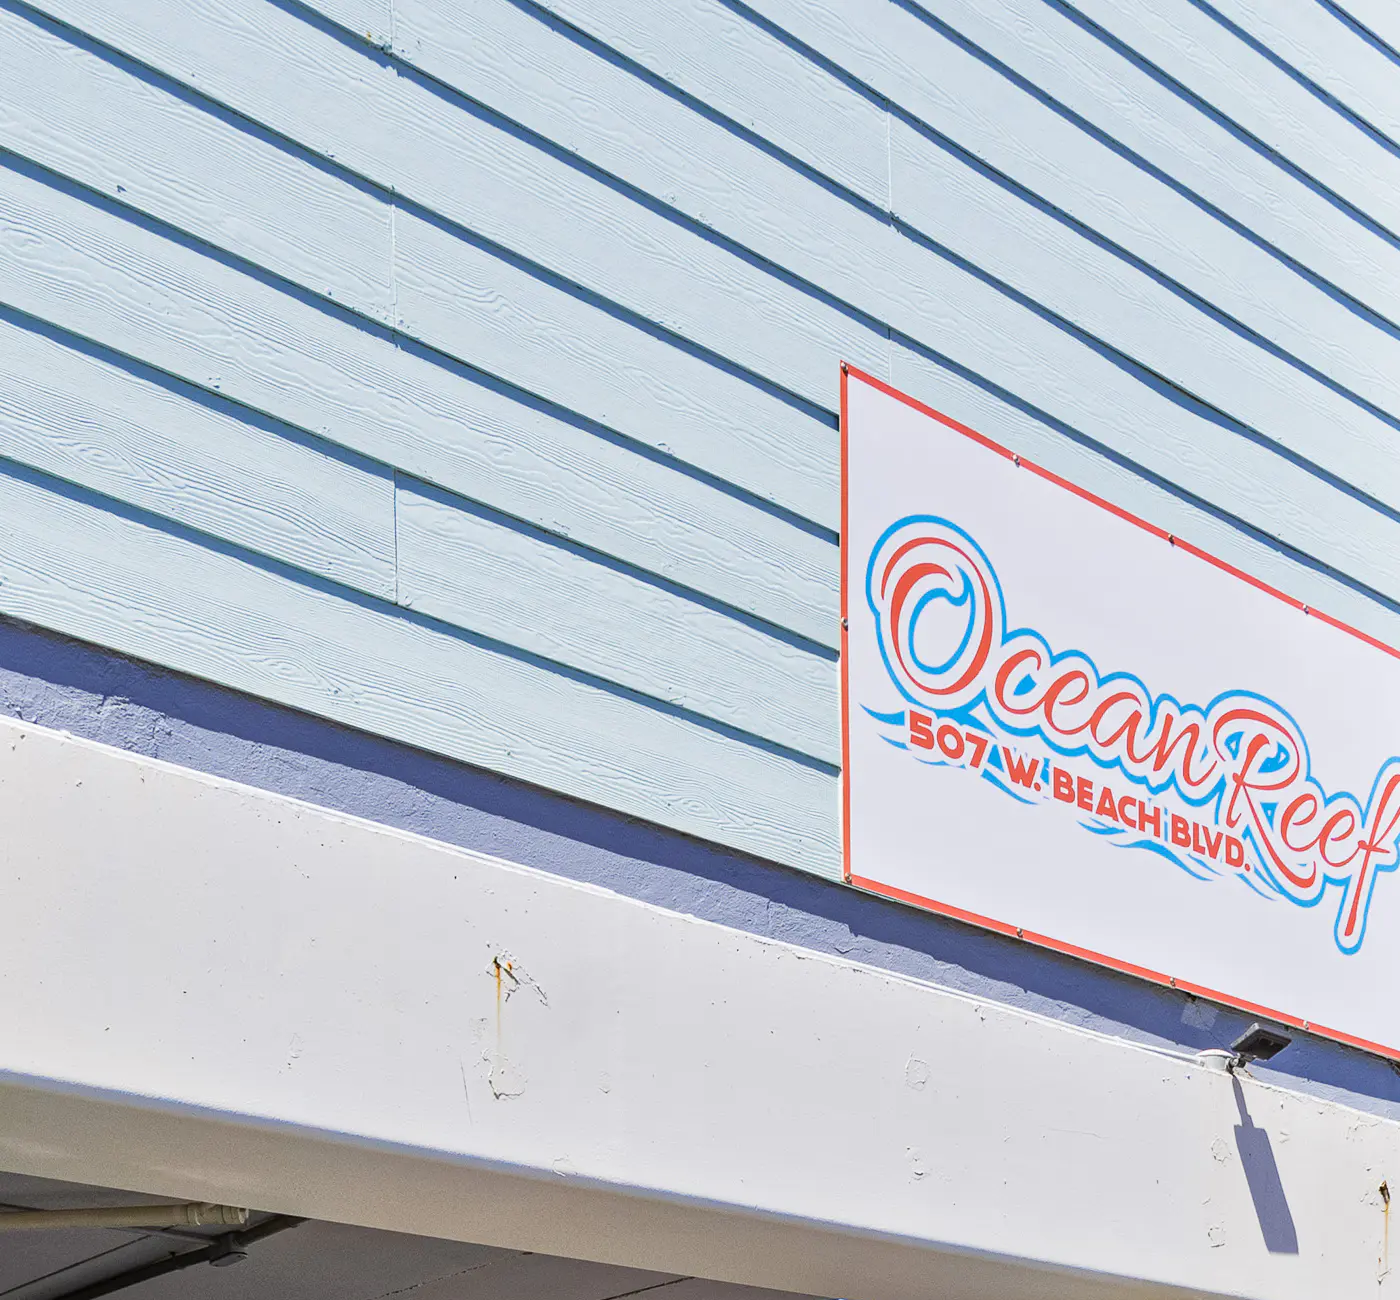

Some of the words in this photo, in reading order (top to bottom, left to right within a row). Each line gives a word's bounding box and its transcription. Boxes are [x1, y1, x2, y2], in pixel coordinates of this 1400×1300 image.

[879, 535, 1218, 788] Ocean
[908, 714, 990, 770] 507
[1001, 744, 1042, 792] W.
[1052, 767, 1162, 839] BEACH
[1170, 815, 1252, 873] BLVD.
